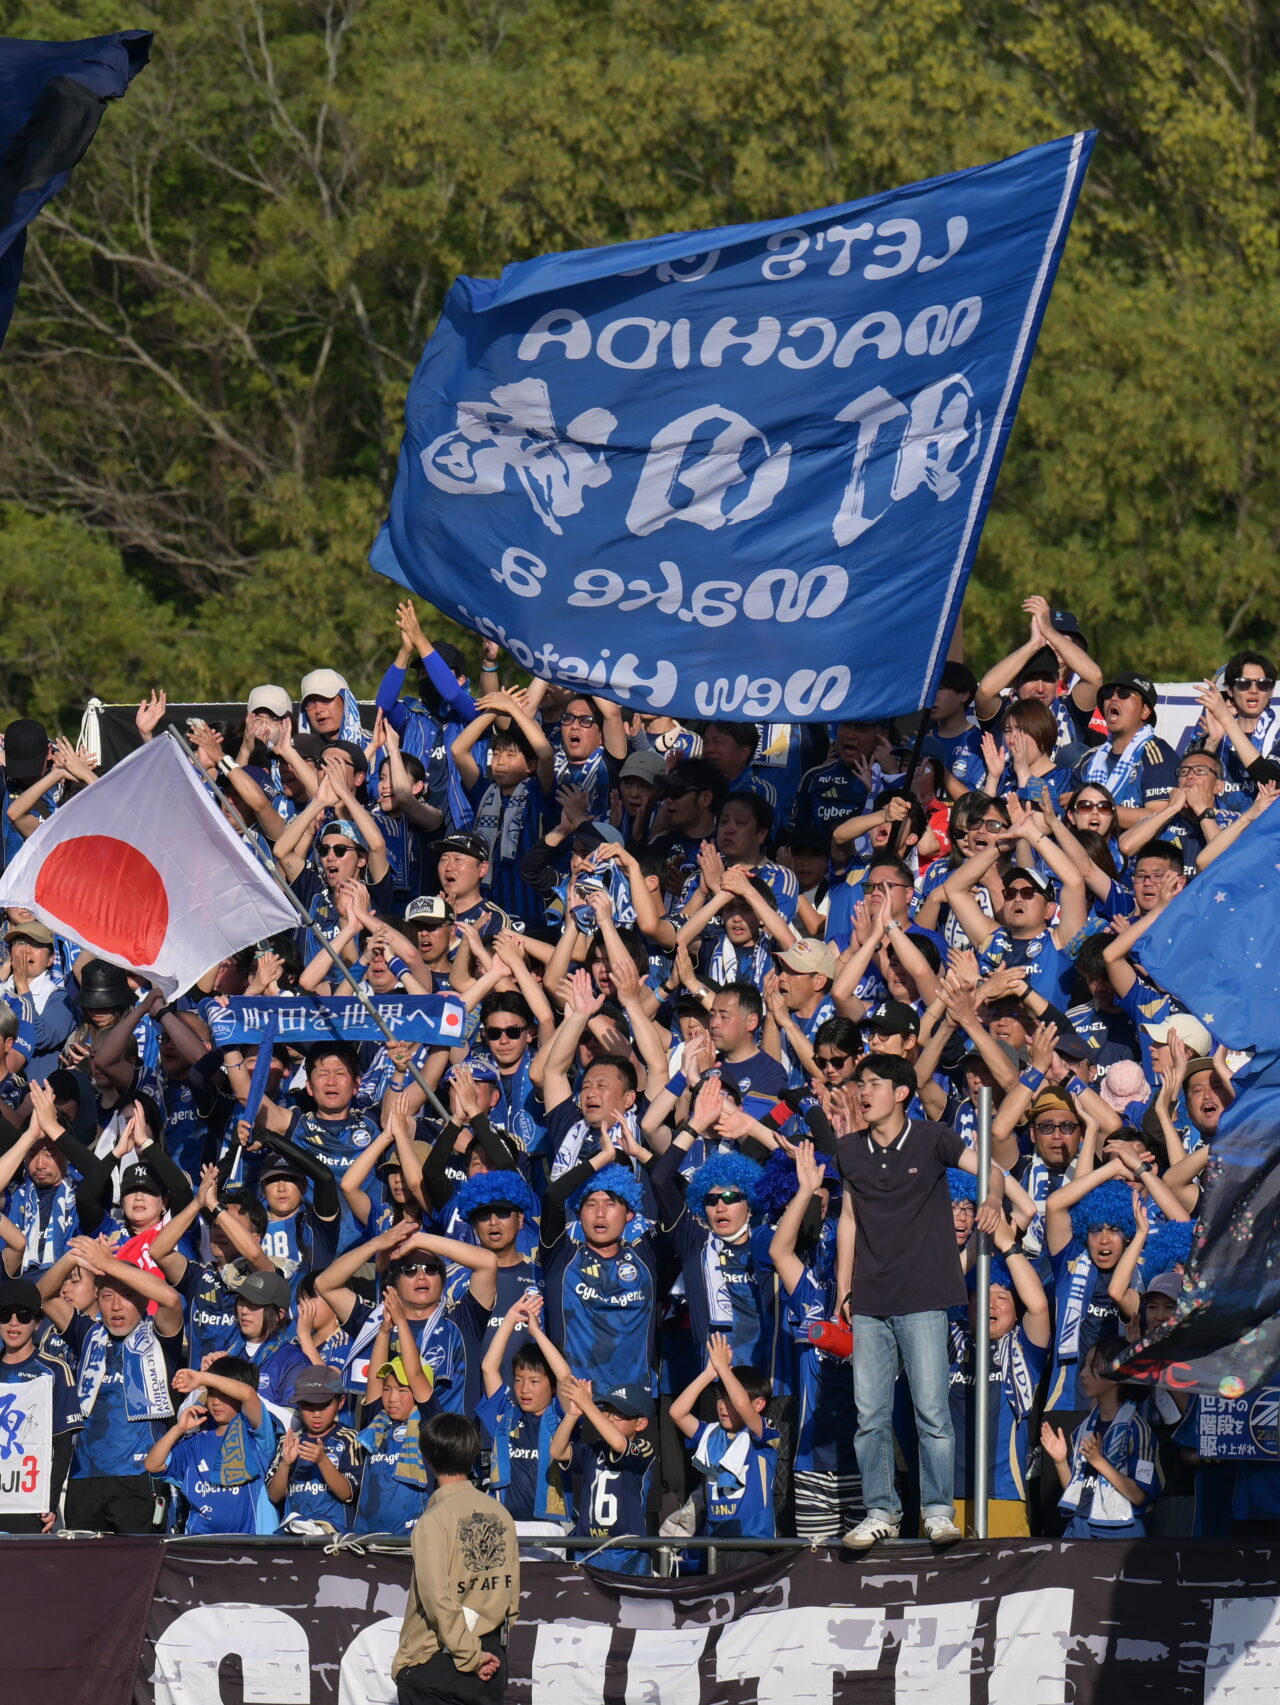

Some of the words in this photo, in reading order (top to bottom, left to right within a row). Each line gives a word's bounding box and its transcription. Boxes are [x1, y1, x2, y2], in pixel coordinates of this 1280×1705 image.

[241, 1003, 436, 1035] 町田を世界へ
[20, 1455, 40, 1493] 3
[457, 1574, 512, 1594] STAFF
